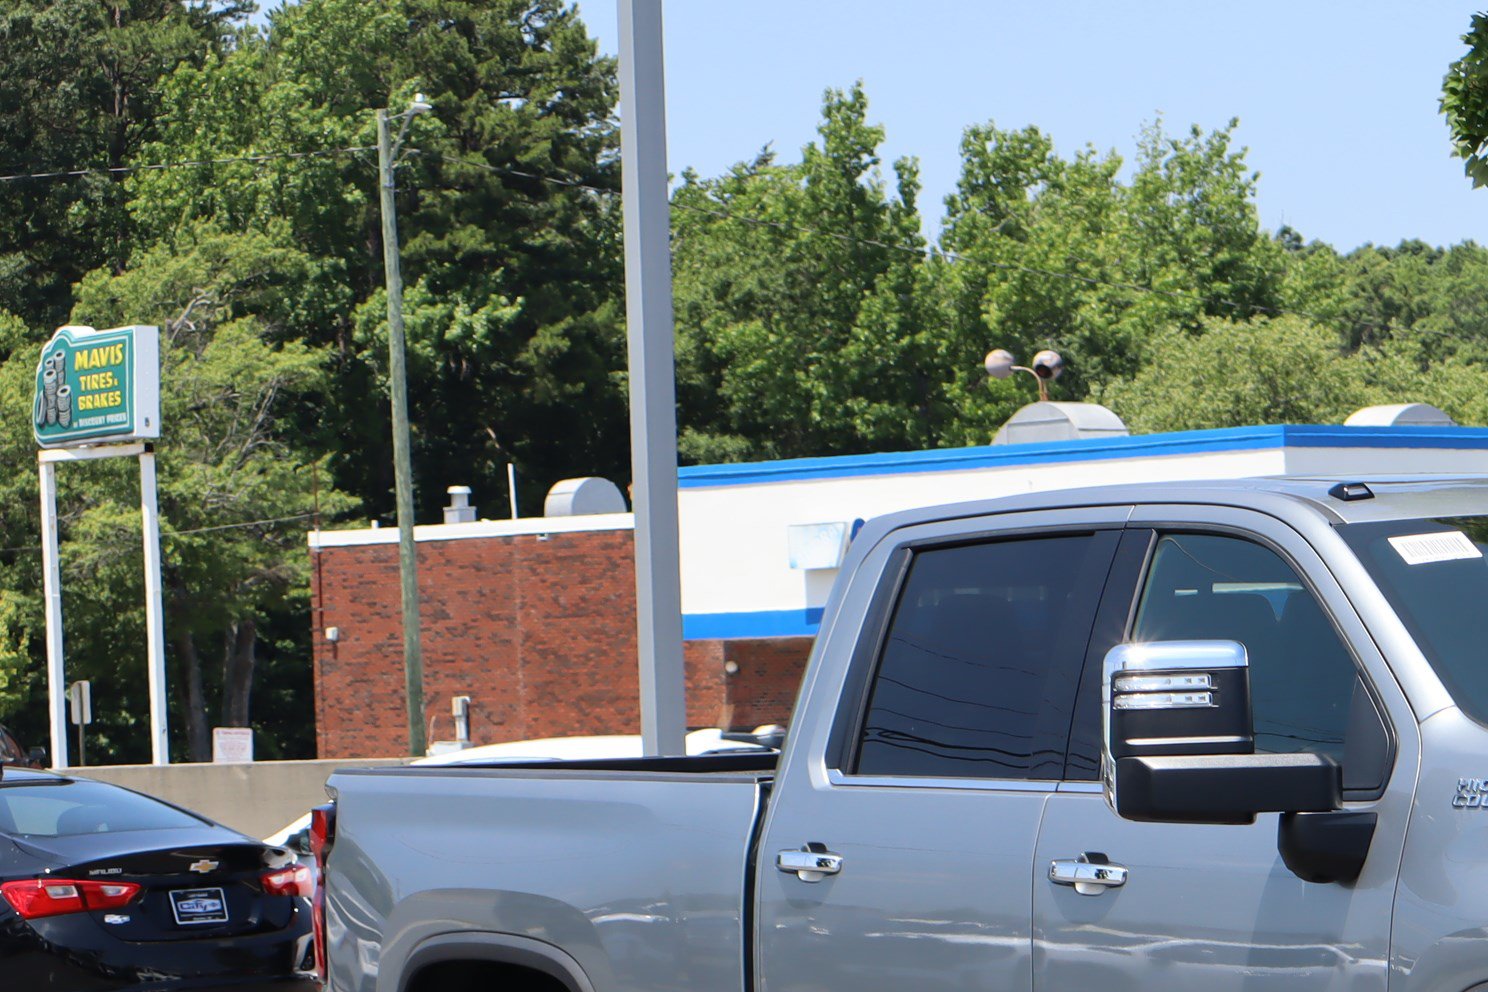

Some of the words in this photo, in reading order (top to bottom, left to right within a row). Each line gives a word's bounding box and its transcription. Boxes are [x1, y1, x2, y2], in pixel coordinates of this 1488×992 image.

[74, 343, 123, 371] MAVIS
[79, 371, 113, 392] TIRES
[77, 390, 121, 411] BRAKES
